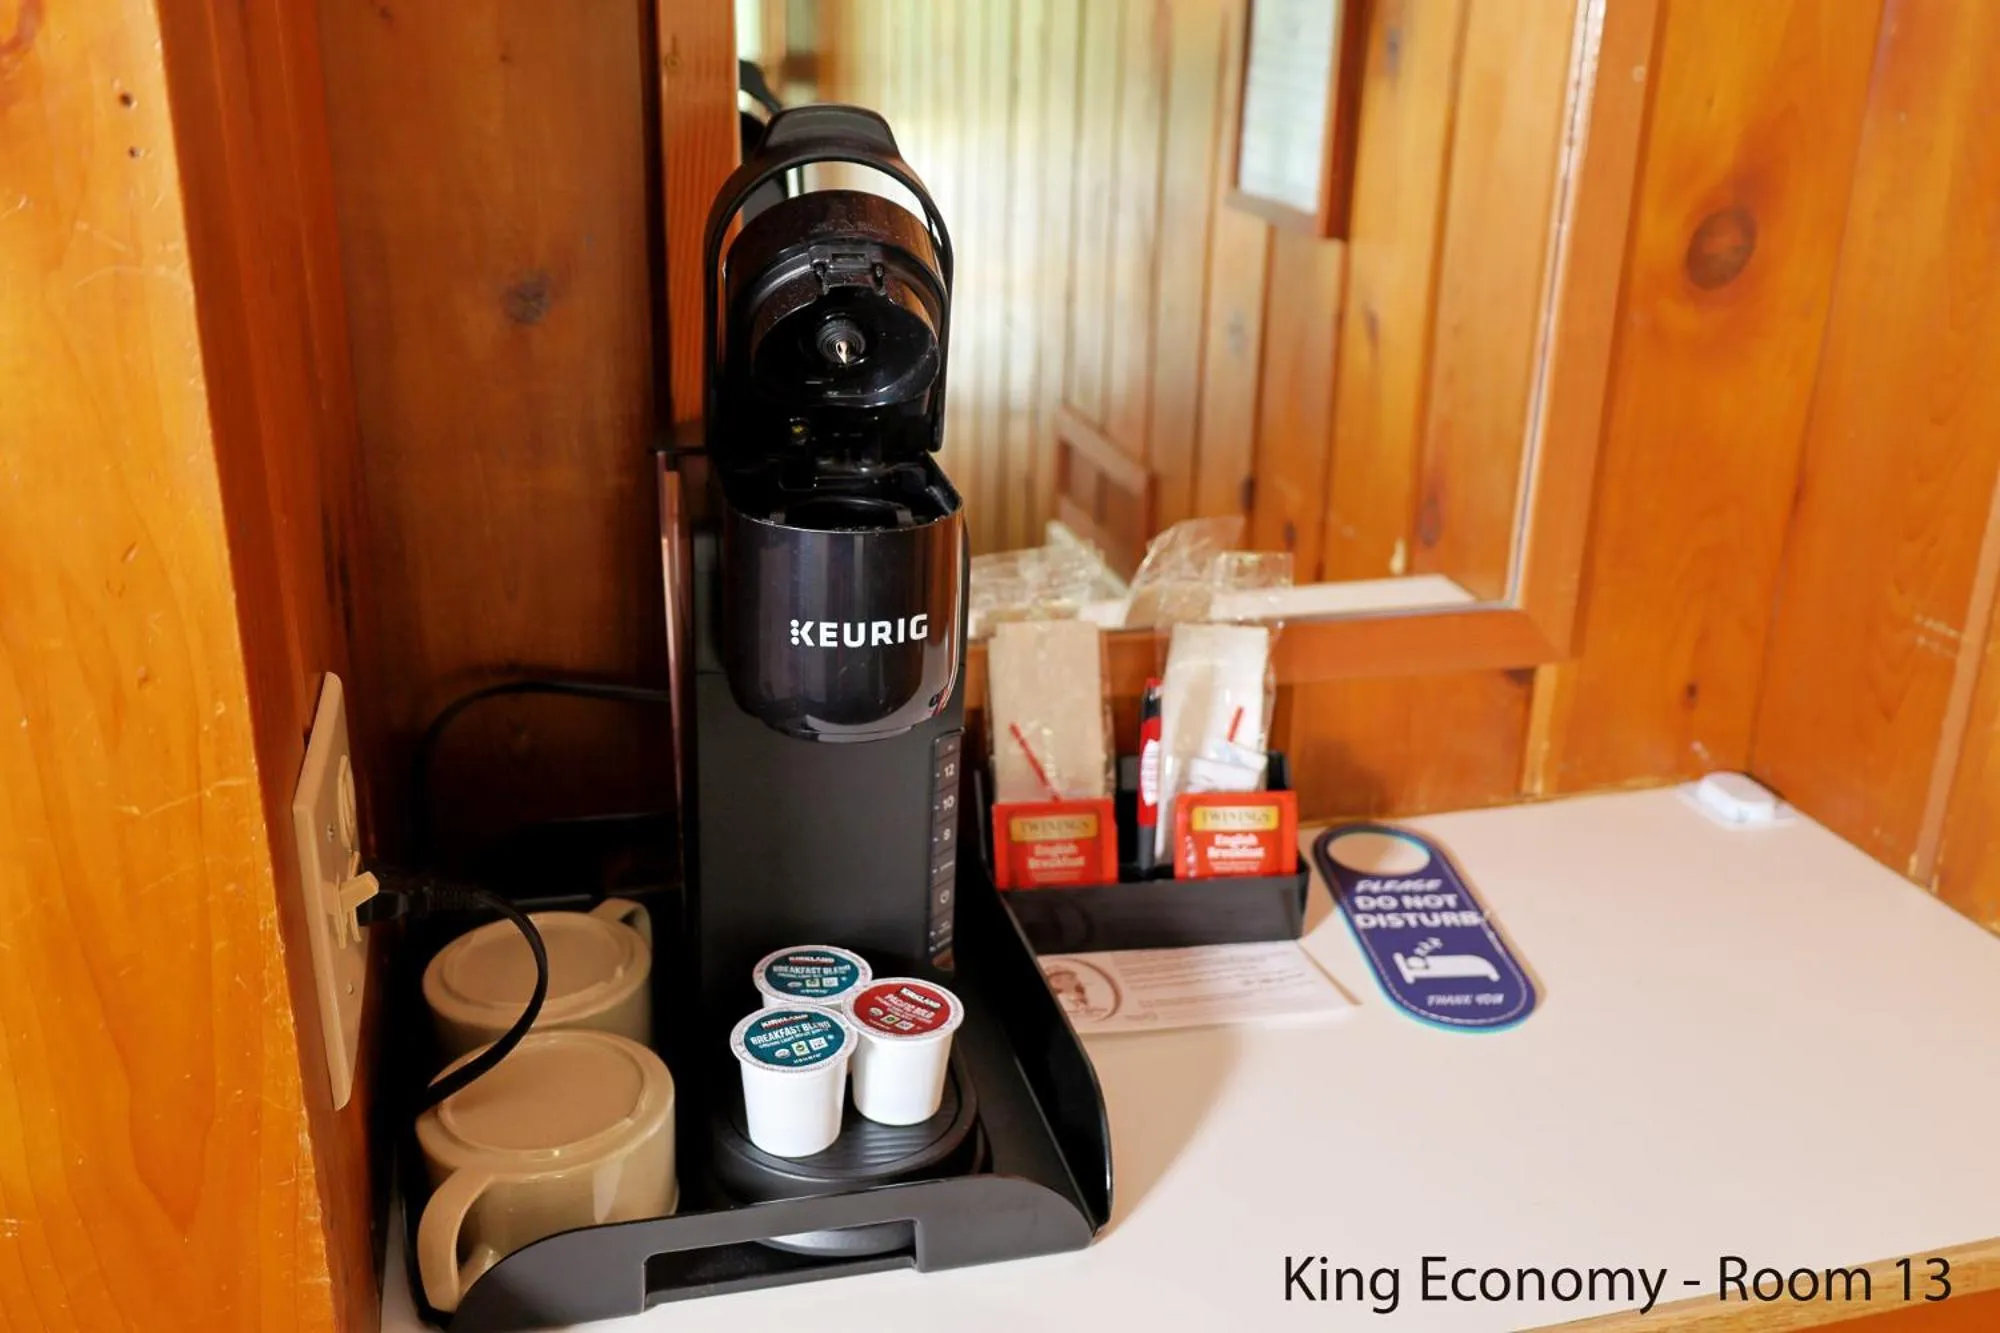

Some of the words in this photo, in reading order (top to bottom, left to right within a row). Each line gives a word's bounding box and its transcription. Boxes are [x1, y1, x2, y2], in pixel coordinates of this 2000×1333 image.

[790, 613, 928, 647] KEURIG
[944, 762, 955, 777] 12
[943, 795, 955, 811] 10
[1201, 811, 1271, 823] TWININGS
[1214, 833, 1259, 849] English
[1207, 846, 1265, 859] Breakfast
[1355, 878, 1442, 893] PLEASE
[1354, 894, 1398, 910] DO
[1401, 893, 1458, 909] NOT
[1354, 911, 1481, 929] DISTURB
[773, 965, 821, 975] BREAKFAST
[750, 1025, 802, 1046] BREAKFAST
